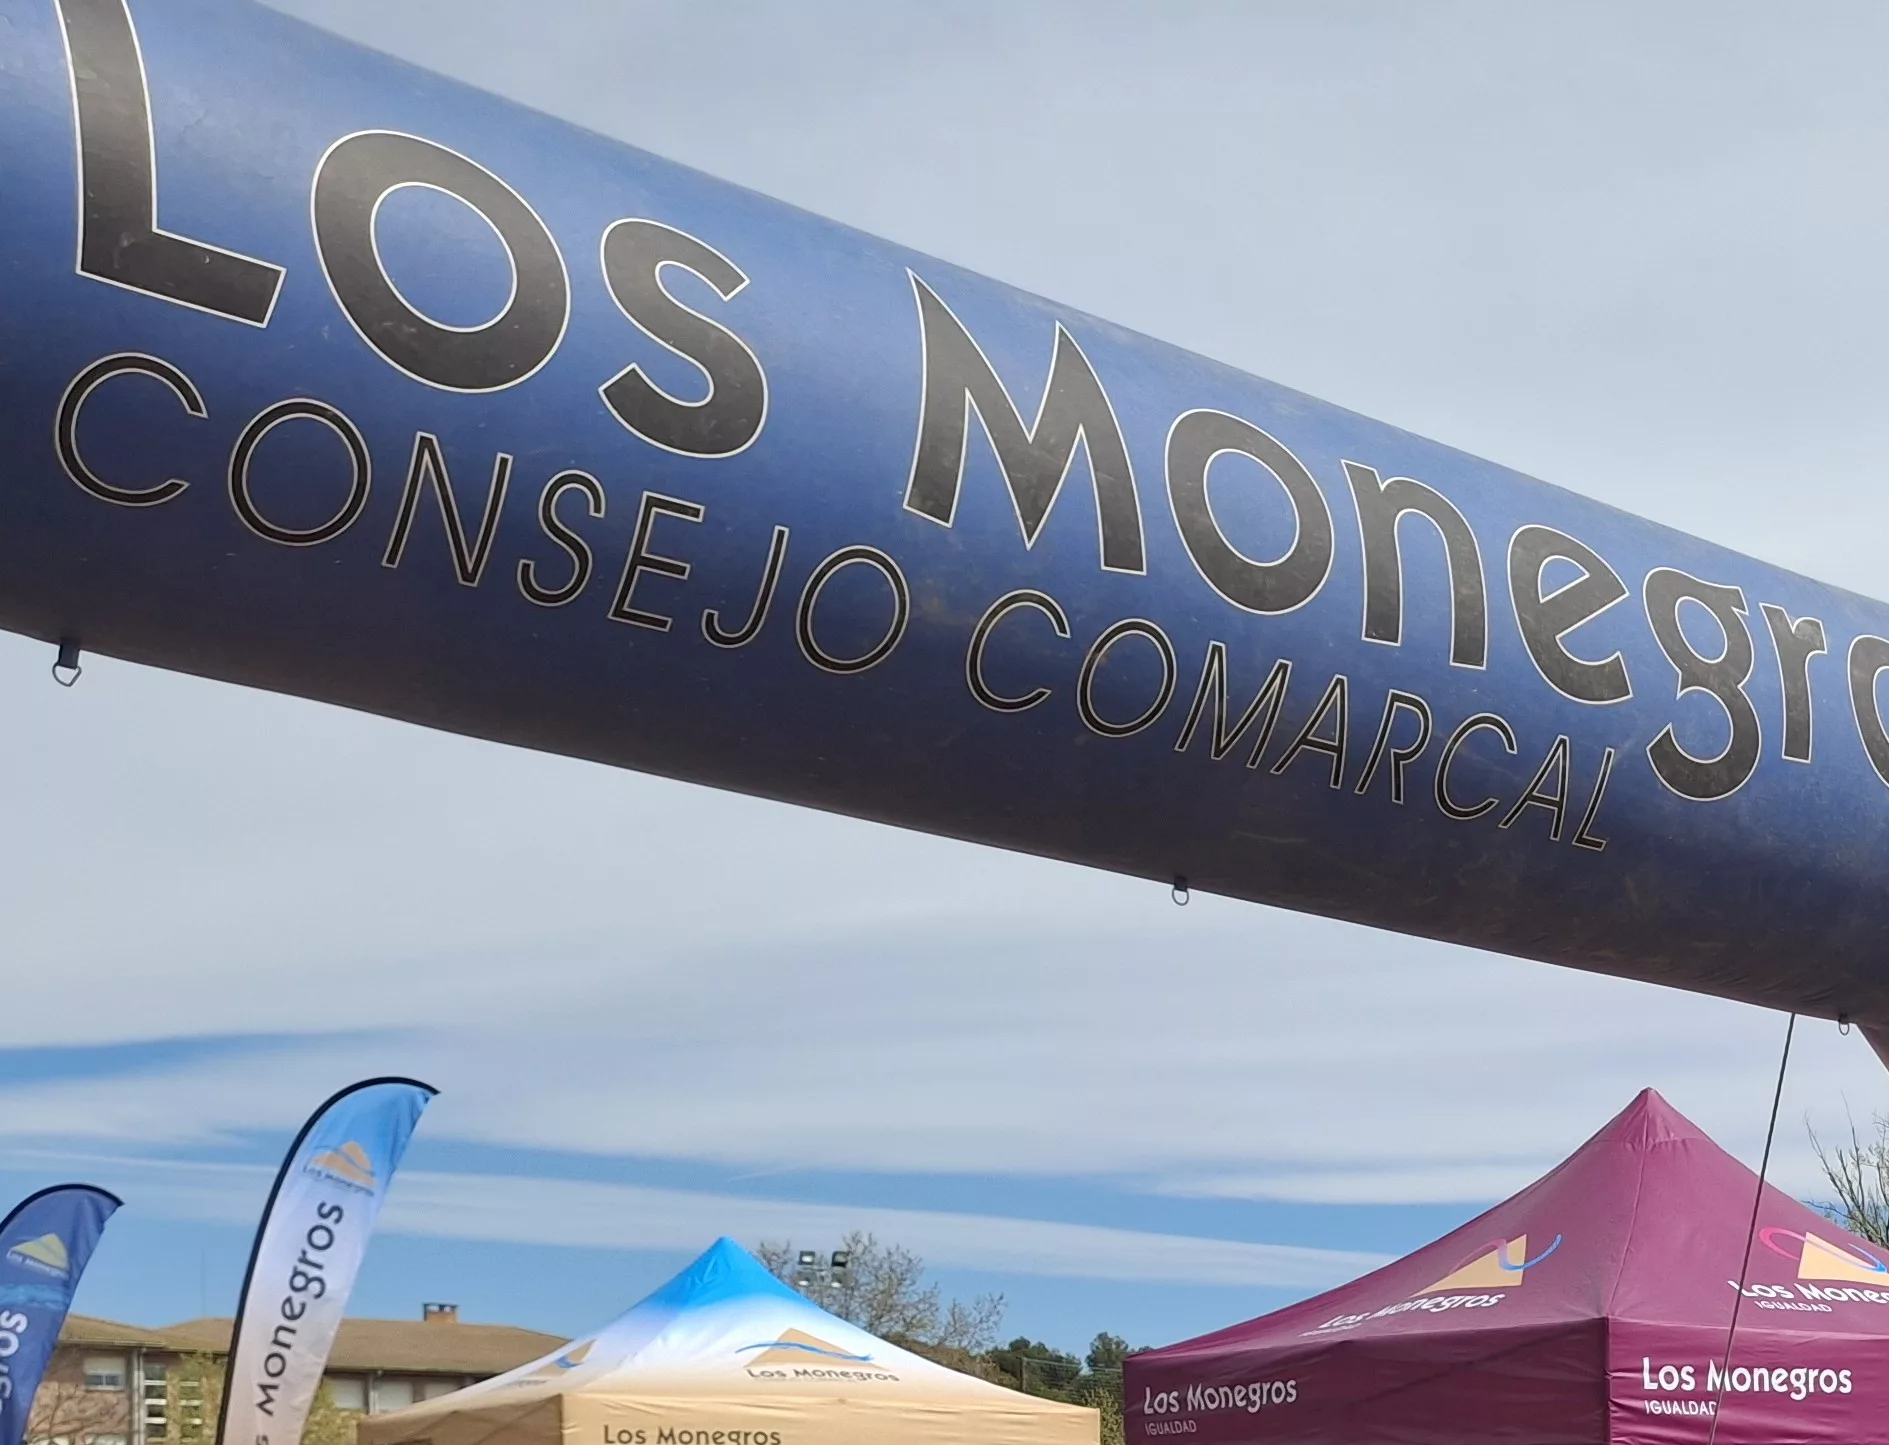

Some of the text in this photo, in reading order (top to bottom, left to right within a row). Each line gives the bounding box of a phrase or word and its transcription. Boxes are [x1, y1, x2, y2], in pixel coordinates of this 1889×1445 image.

[55, 352, 1618, 851] CONSEJO COMARCAL
[1727, 1280, 1795, 1298] Los
[257, 1199, 344, 1419] Monegros
[1318, 1293, 1506, 1329] Los Monegros
[1753, 1300, 1834, 1313] IGUALDAD
[793, 1368, 900, 1382] Monegros
[1642, 1356, 1853, 1401] Los Monegros
[1143, 1378, 1298, 1415] Los Monegros
[603, 1424, 647, 1445] Los
[1144, 1419, 1197, 1436] IGUALDAD
